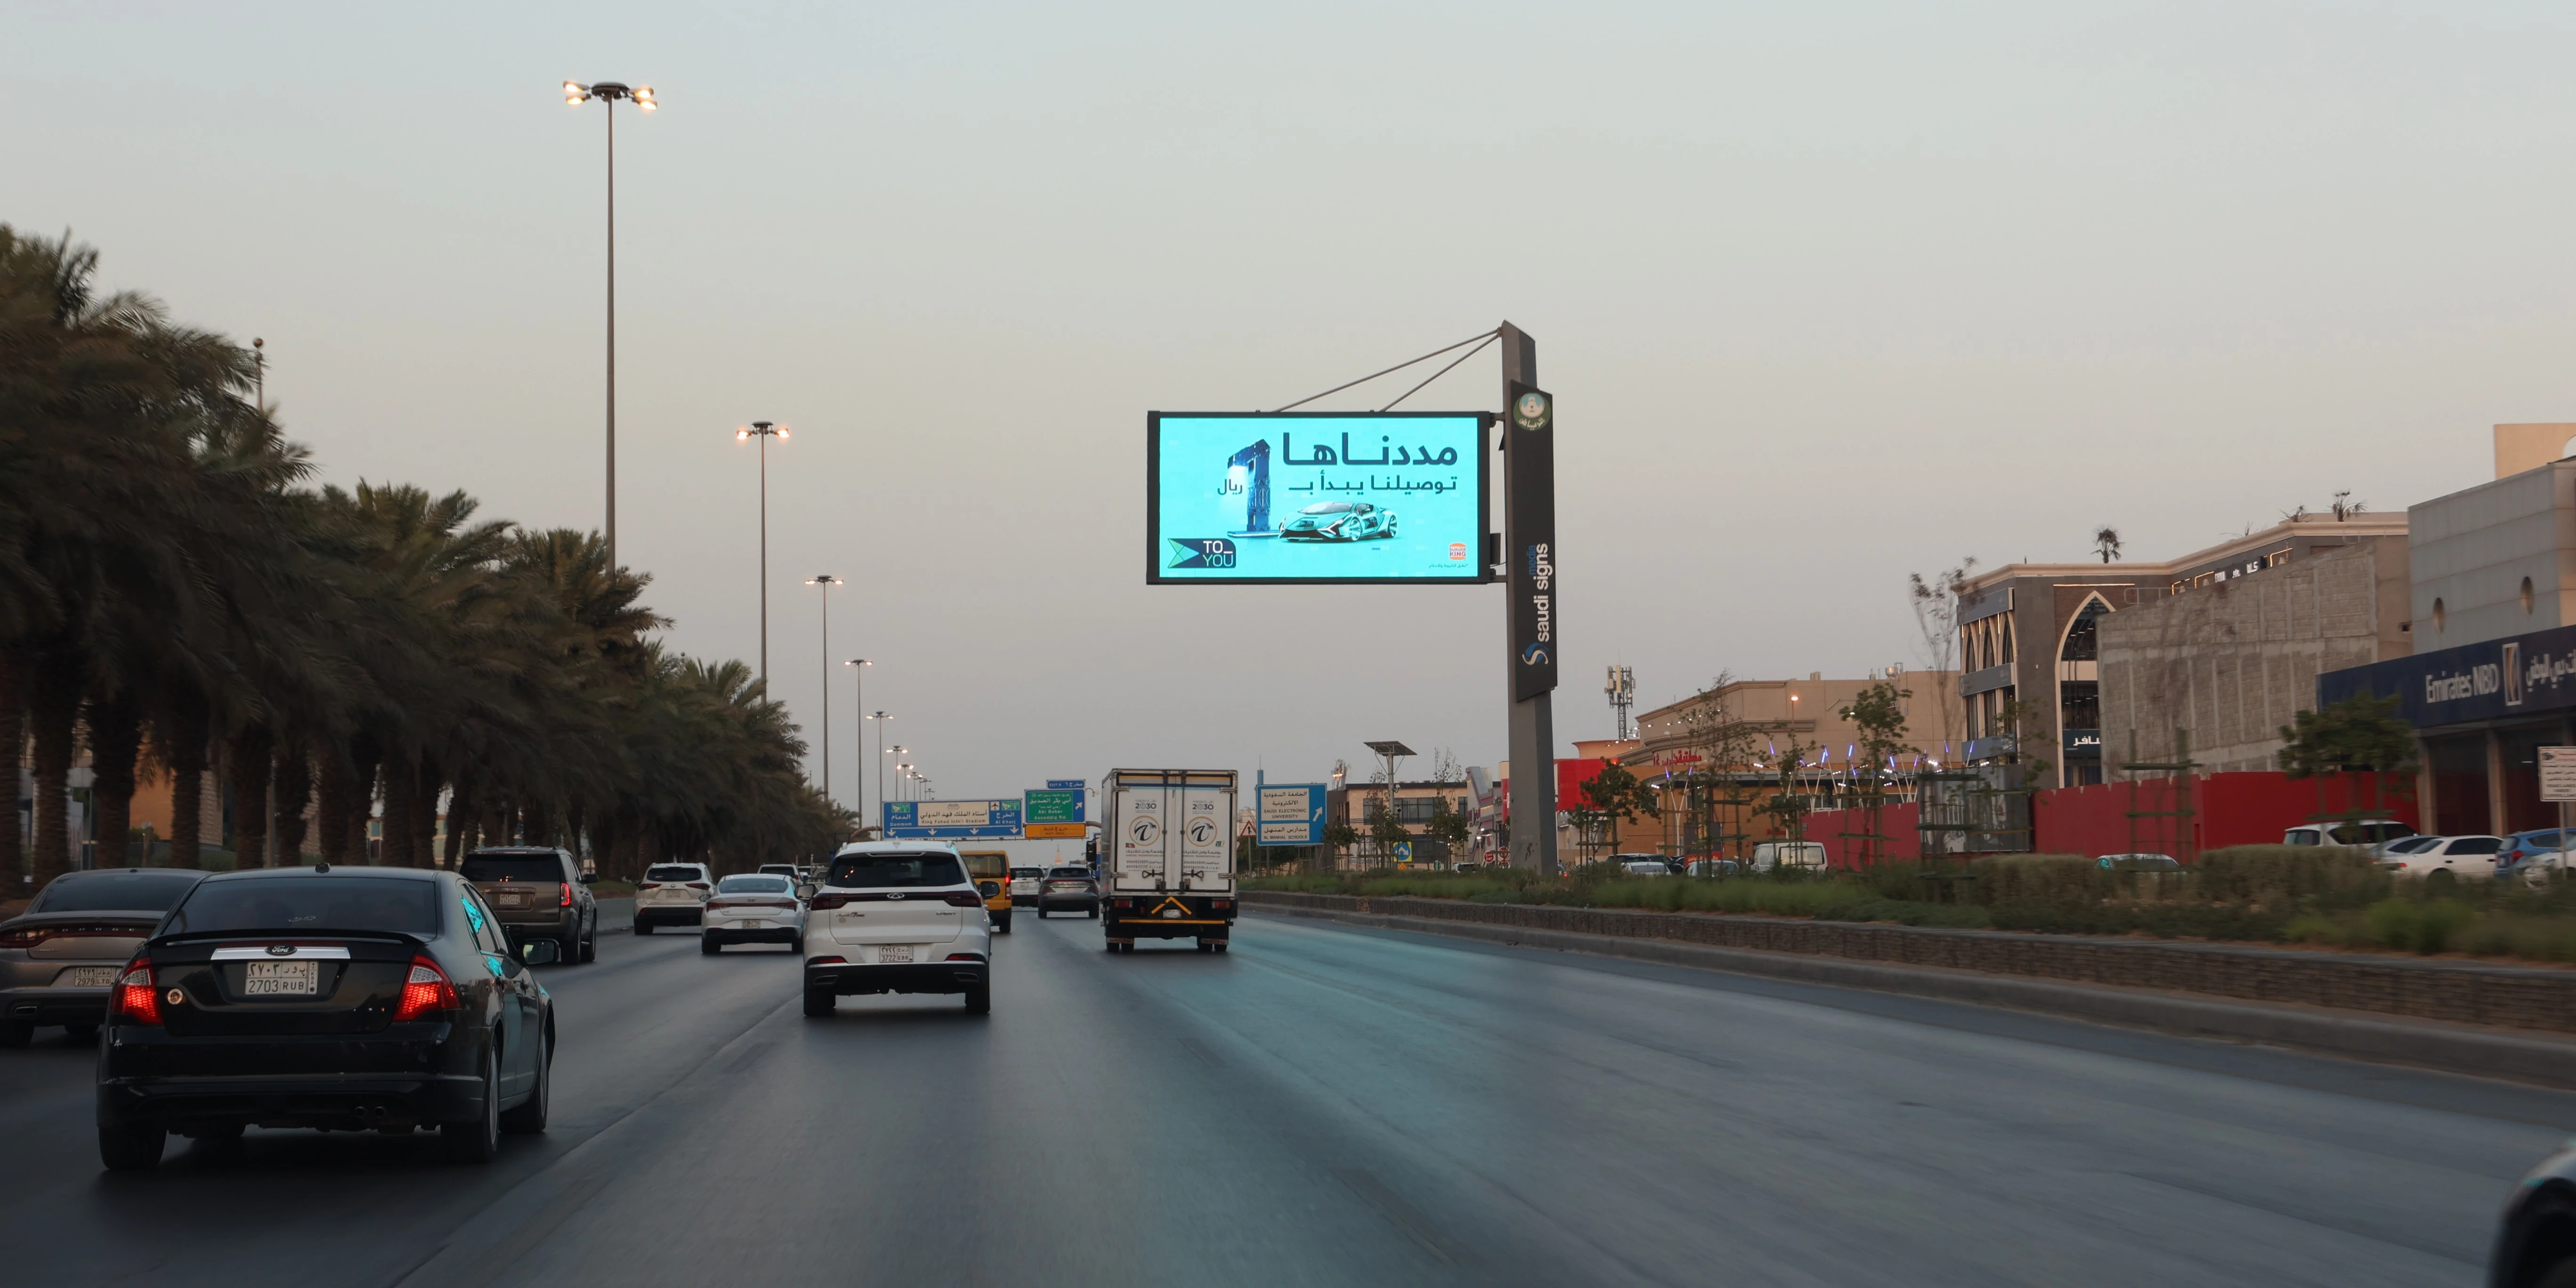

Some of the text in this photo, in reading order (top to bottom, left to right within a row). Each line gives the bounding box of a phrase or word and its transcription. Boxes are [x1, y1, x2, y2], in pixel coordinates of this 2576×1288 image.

[1519, 418, 1546, 431] الرياض
[1283, 432, 1457, 466] مددناها
[1217, 479, 1242, 495] ريال
[1320, 470, 1364, 495] يبدأ
[1371, 475, 1457, 495] توصيلنا
[1202, 554, 1233, 566] YOU
[1527, 545, 1536, 575] media
[1533, 543, 1553, 642] saudi signs
[2425, 663, 2499, 703] Emirates NBD
[249, 980, 304, 993] 2703 RUB
